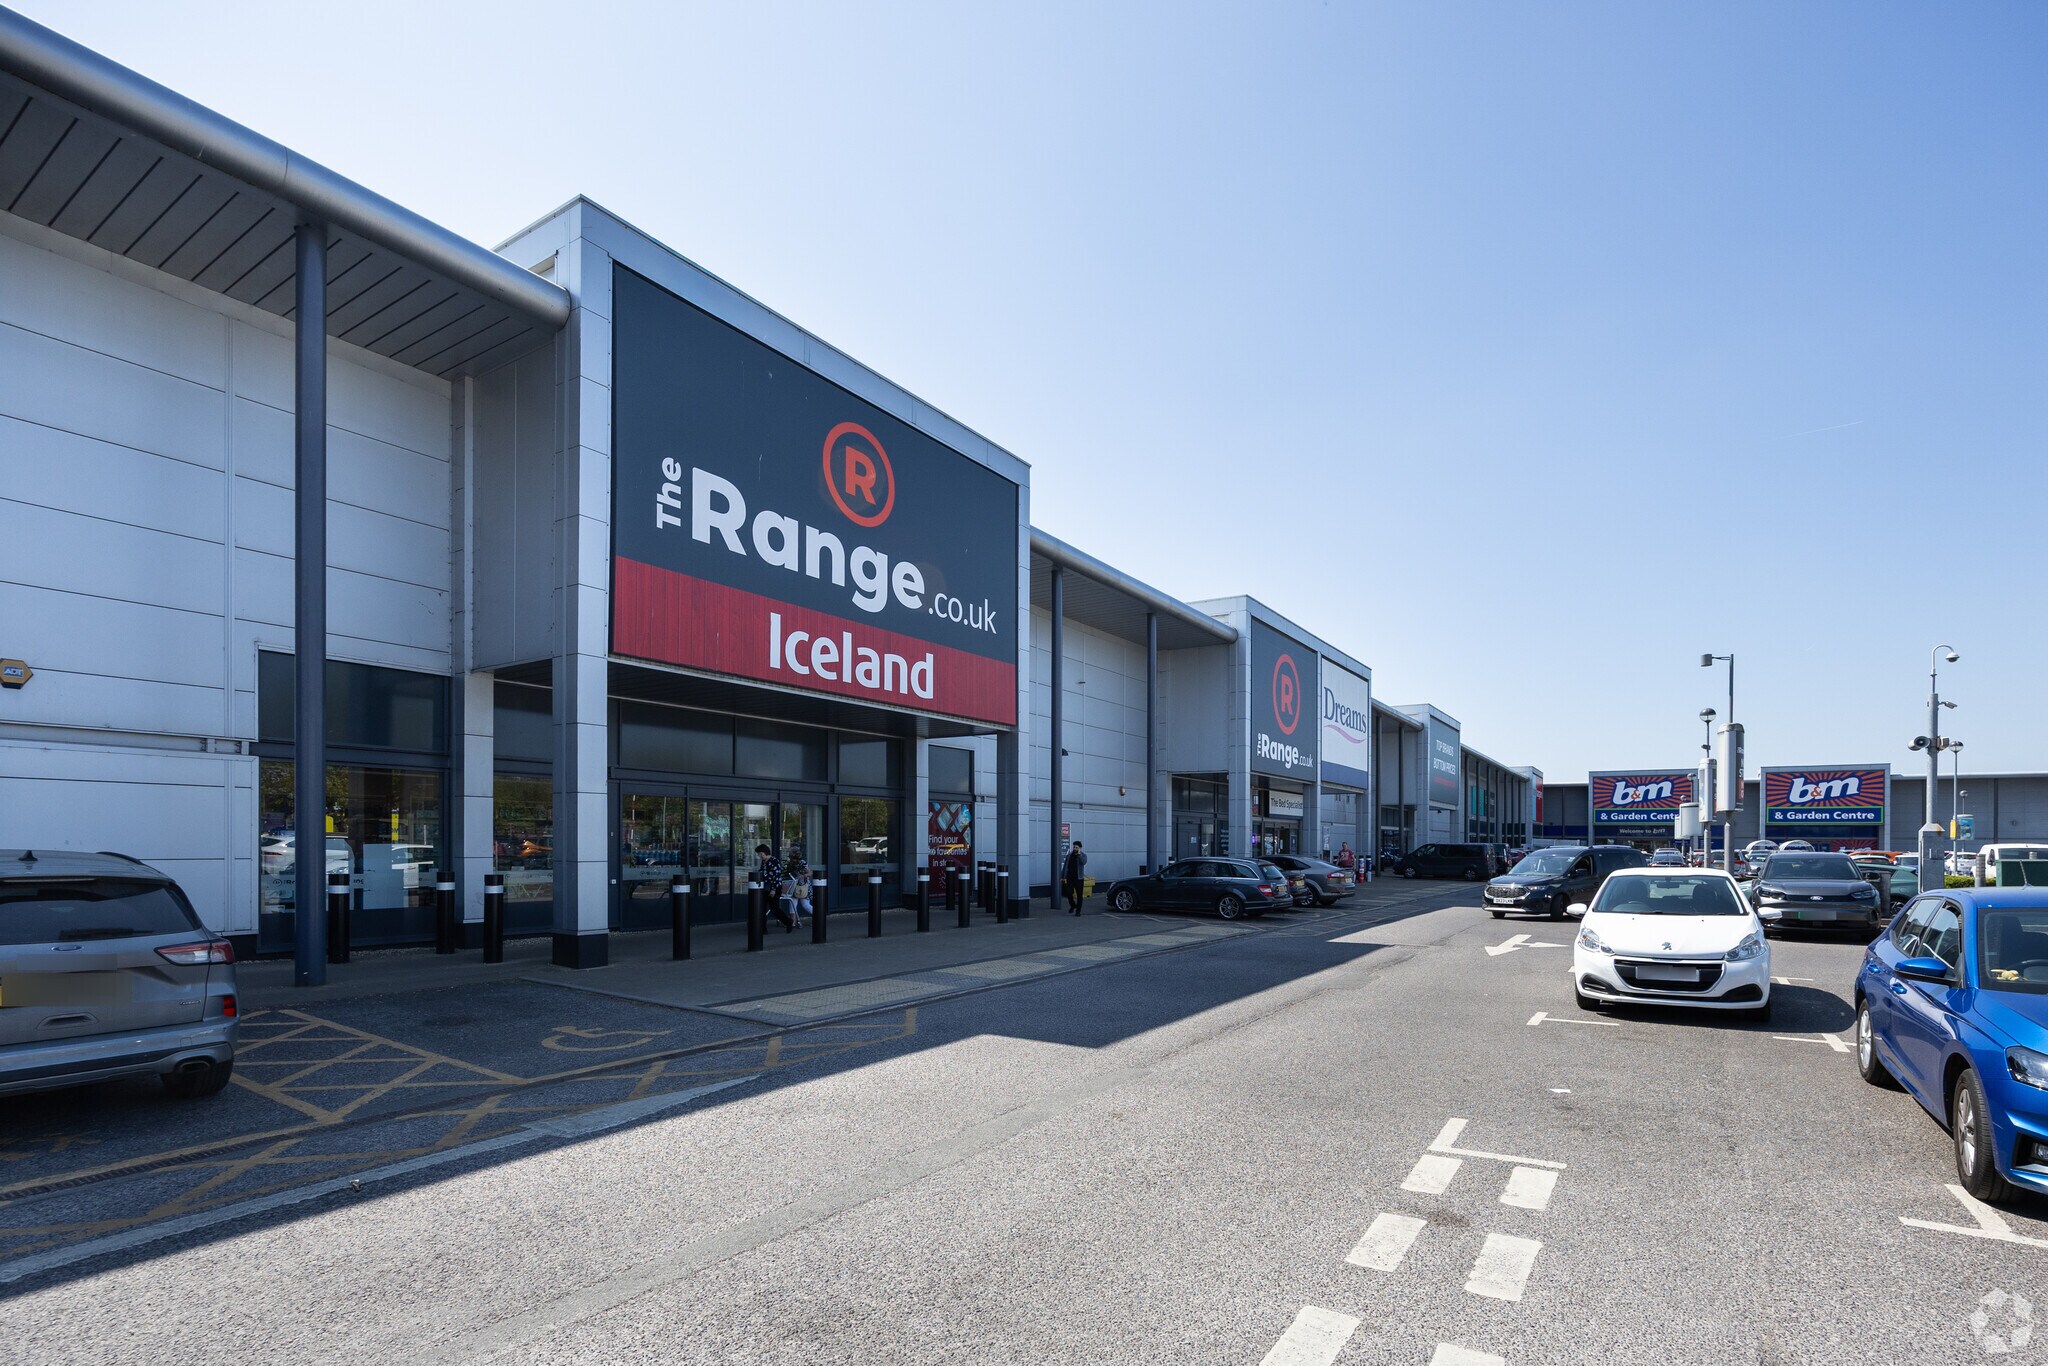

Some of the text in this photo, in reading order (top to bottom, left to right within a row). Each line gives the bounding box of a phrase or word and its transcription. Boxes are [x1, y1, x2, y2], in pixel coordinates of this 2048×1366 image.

[656, 457, 682, 529] The
[769, 612, 934, 699] Iceland
[3, 668, 23, 676] ADT
[1323, 686, 1367, 733] Dreams
[1612, 781, 1672, 805] b&m
[1788, 777, 1860, 803] b&m
[1600, 812, 1608, 820] &
[1610, 812, 1647, 820] Garden
[1774, 811, 1875, 820] & Garden Centre
[928, 834, 958, 845] Find your
